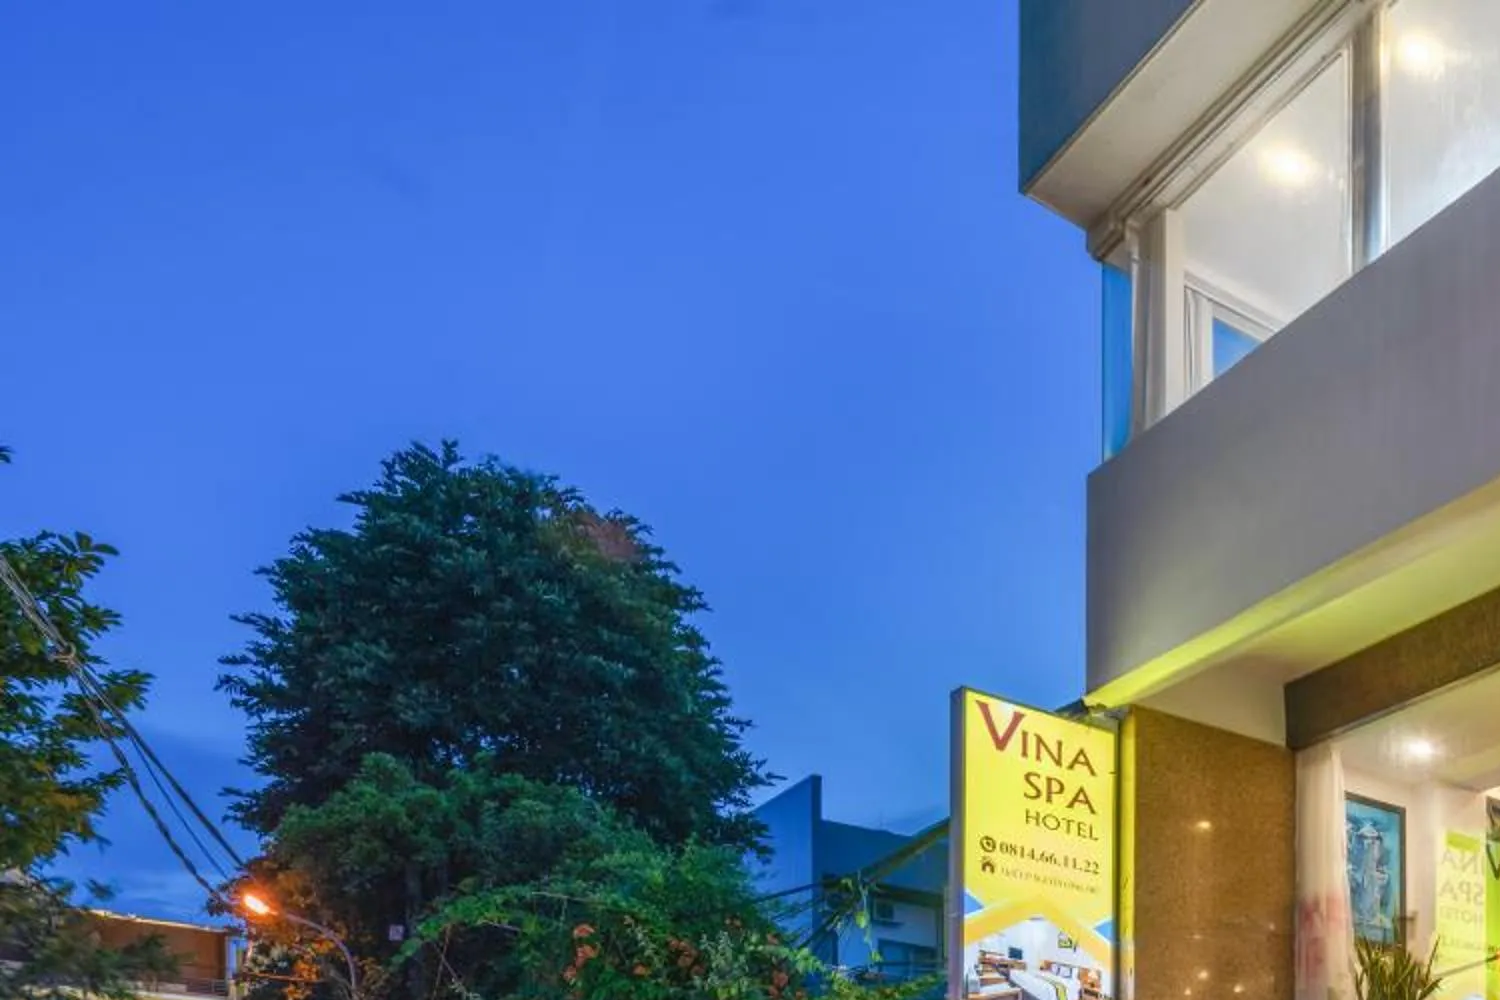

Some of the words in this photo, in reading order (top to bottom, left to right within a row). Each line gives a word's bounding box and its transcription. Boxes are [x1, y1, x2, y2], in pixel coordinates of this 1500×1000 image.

[975, 700, 1097, 777] VINA
[1024, 771, 1097, 815] SPA
[1024, 808, 1099, 841] HOTEL
